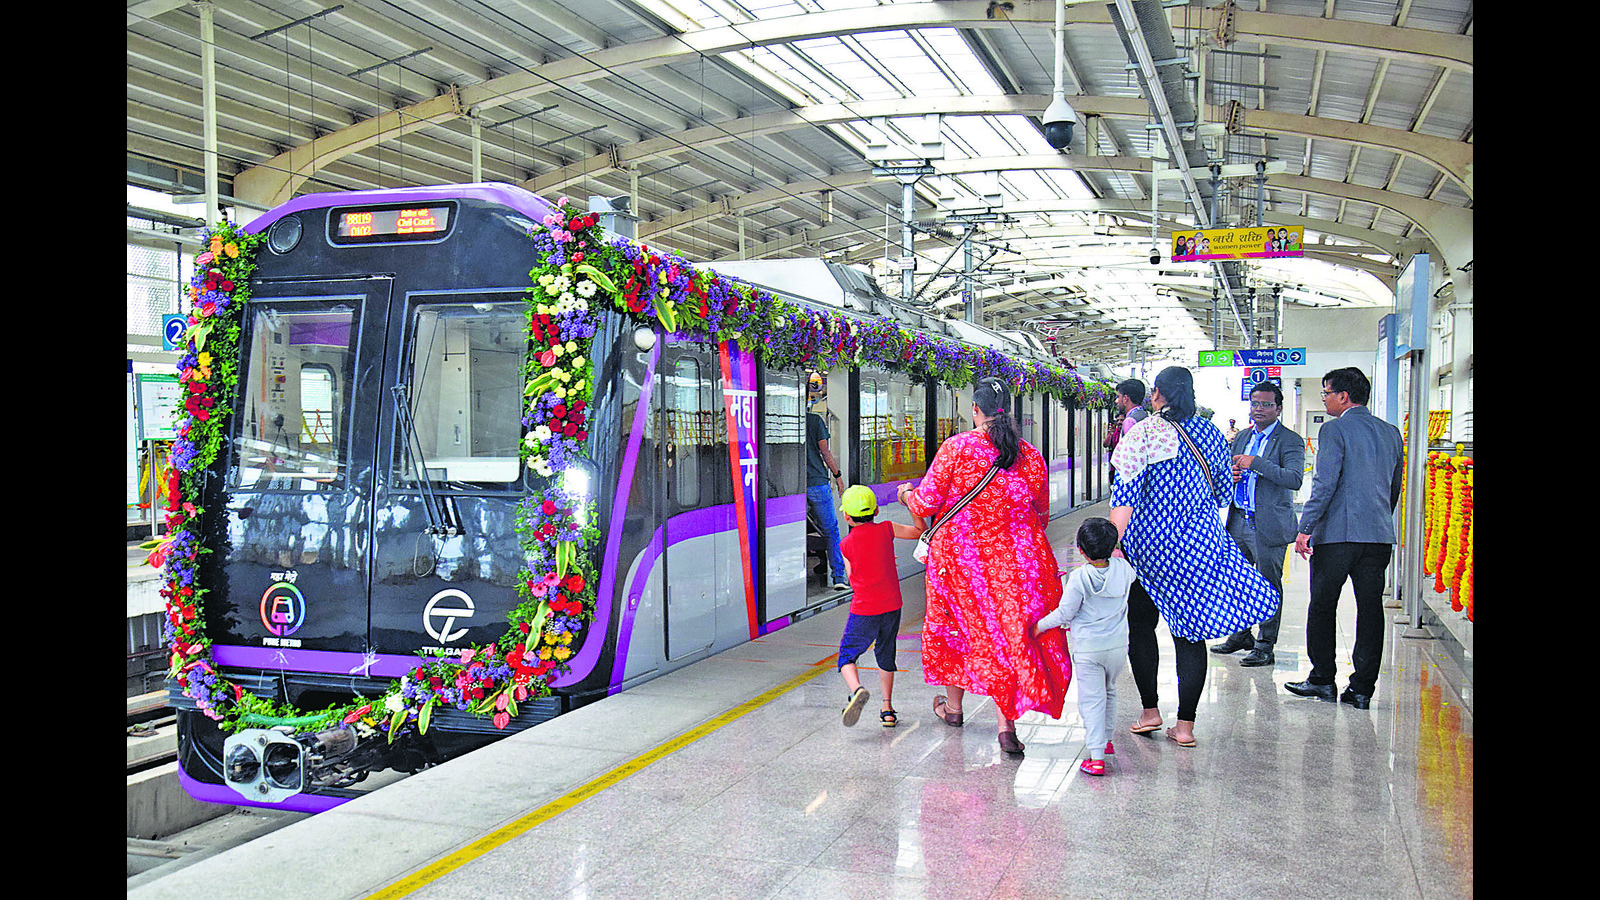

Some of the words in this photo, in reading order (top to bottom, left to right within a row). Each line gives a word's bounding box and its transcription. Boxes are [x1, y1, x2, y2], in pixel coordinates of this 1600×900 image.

[346, 212, 372, 225] 88119
[397, 217, 412, 227] Civil
[413, 216, 436, 226] Court
[1212, 232, 1234, 244] नारी
[1239, 231, 1263, 243] शक्ति
[1238, 243, 1262, 251] power
[170, 321, 183, 342] 2
[1255, 371, 1261, 382] 1
[723, 388, 758, 443] महा
